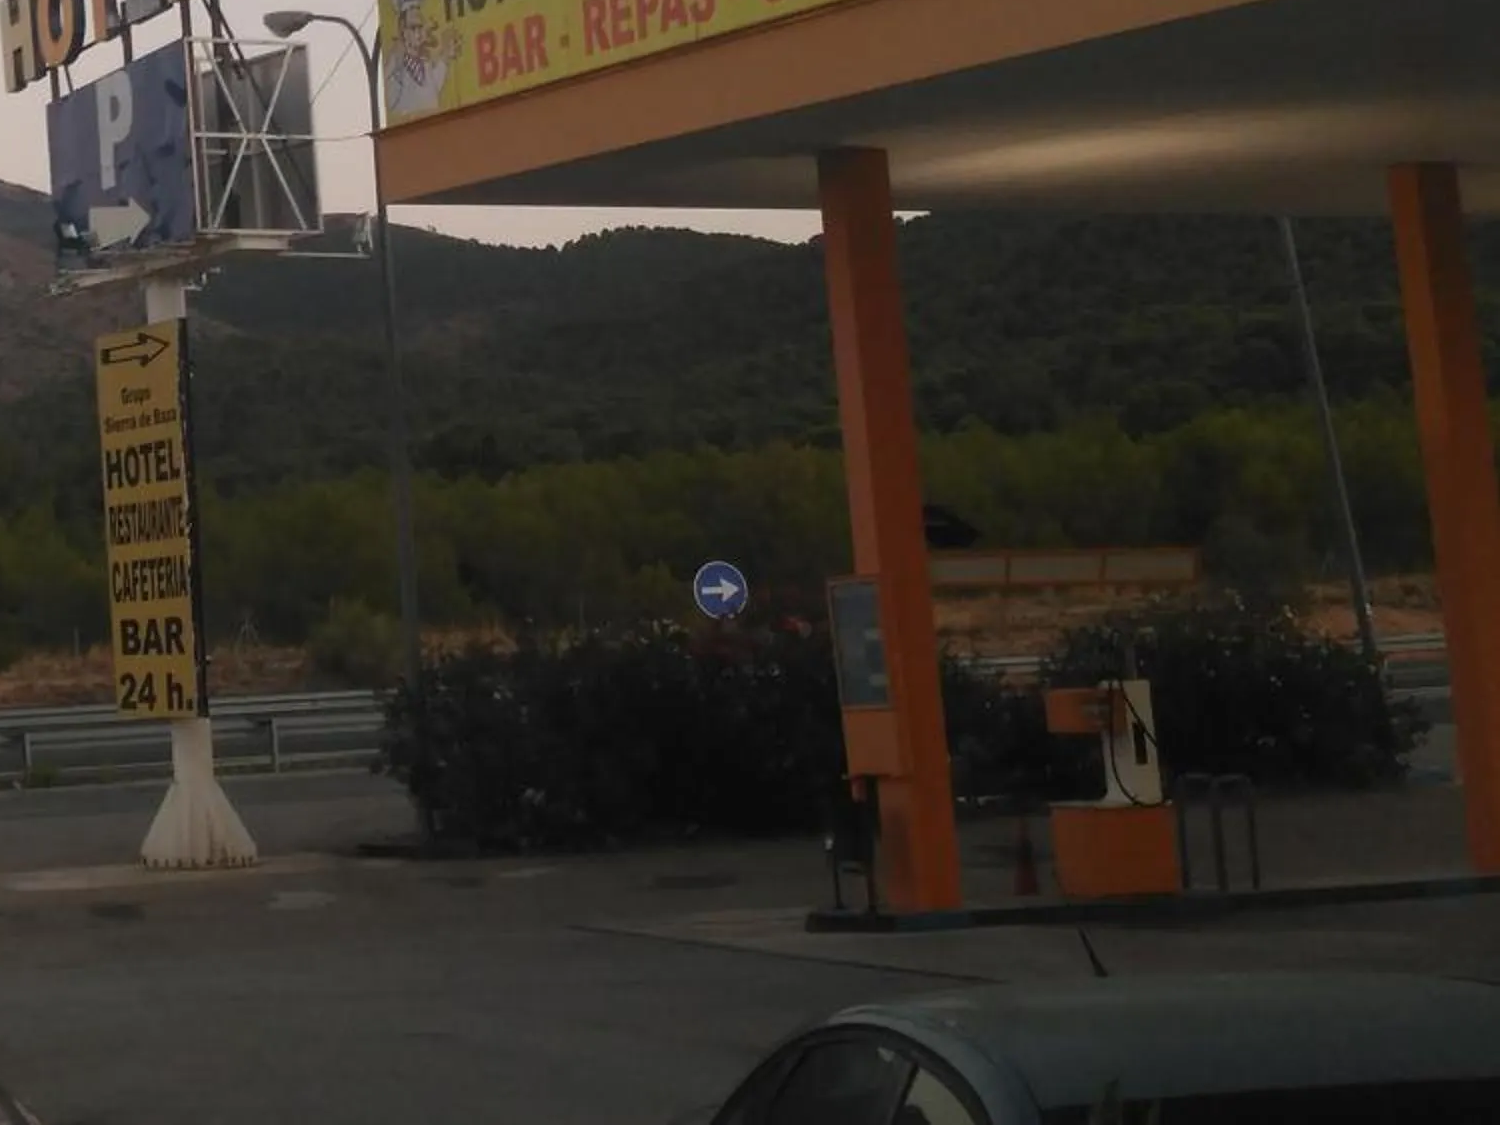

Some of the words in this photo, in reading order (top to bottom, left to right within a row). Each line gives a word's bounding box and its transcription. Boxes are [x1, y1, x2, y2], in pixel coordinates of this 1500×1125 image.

[476, 13, 549, 88] BAR
[95, 69, 134, 191] P
[104, 416, 137, 434] Sierra
[105, 439, 181, 490] HOTEL
[108, 495, 186, 546] RESTAURANTE
[112, 556, 189, 605] CAFETERIA
[120, 616, 186, 656] BAR
[119, 672, 156, 711] 24
[167, 670, 194, 711] h.
